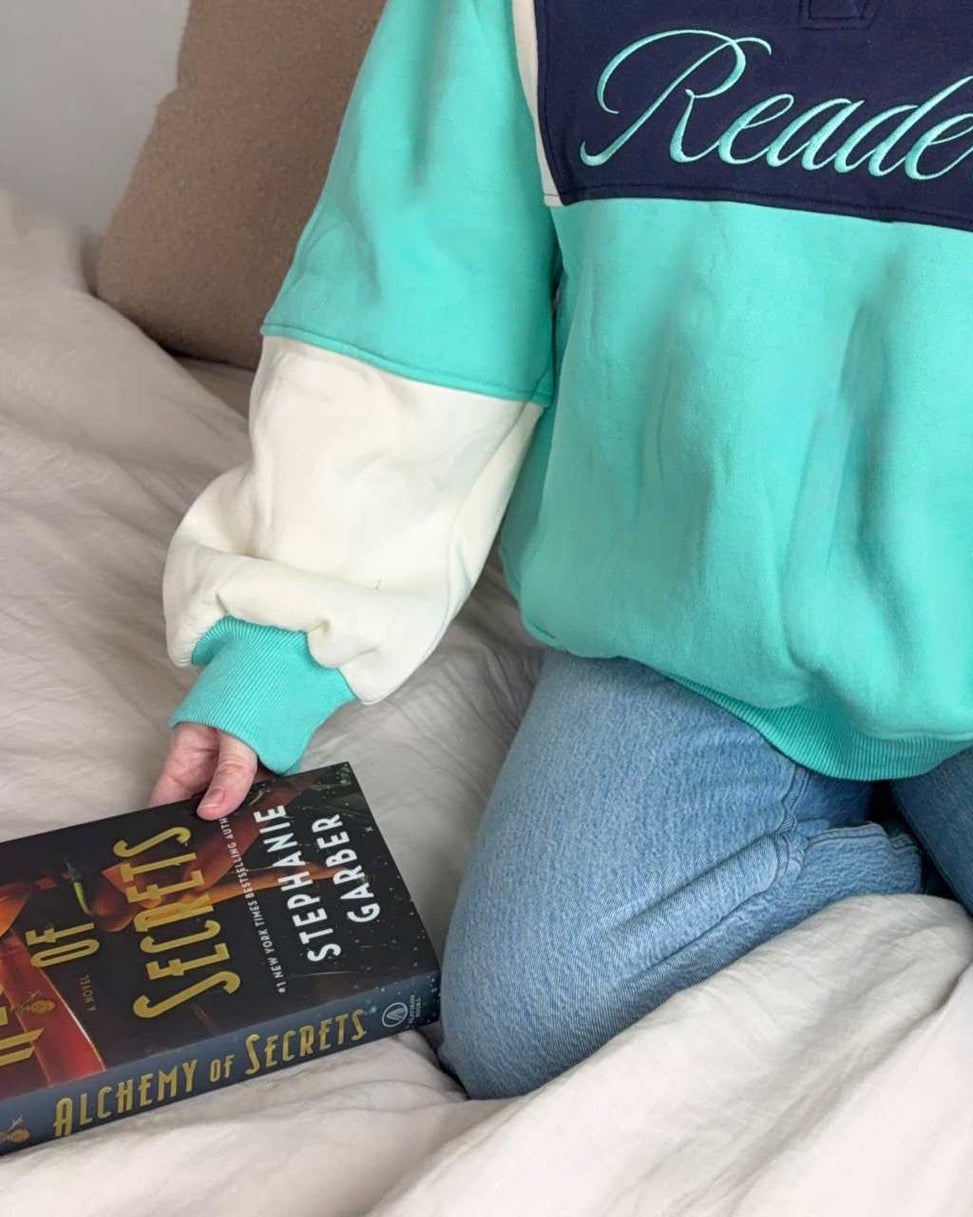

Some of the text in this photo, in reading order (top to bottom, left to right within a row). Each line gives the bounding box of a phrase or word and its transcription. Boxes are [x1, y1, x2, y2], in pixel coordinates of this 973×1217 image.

[218, 817, 235, 841] AUTH
[227, 843, 254, 900] BESTSELLING
[253, 804, 341, 962] STEPHANIE
[311, 814, 381, 923] GARBER
[113, 826, 241, 1019] SECRETS
[248, 900, 265, 927] TIMES
[25, 922, 100, 968] OF
[258, 929, 275, 955] YORK
[80, 974, 95, 1004] NOVEL
[268, 957, 286, 980] NEW
[53, 1059, 198, 1136] ALCHEMY
[209, 1054, 235, 1083] OF
[245, 1008, 367, 1075] SECRETS
